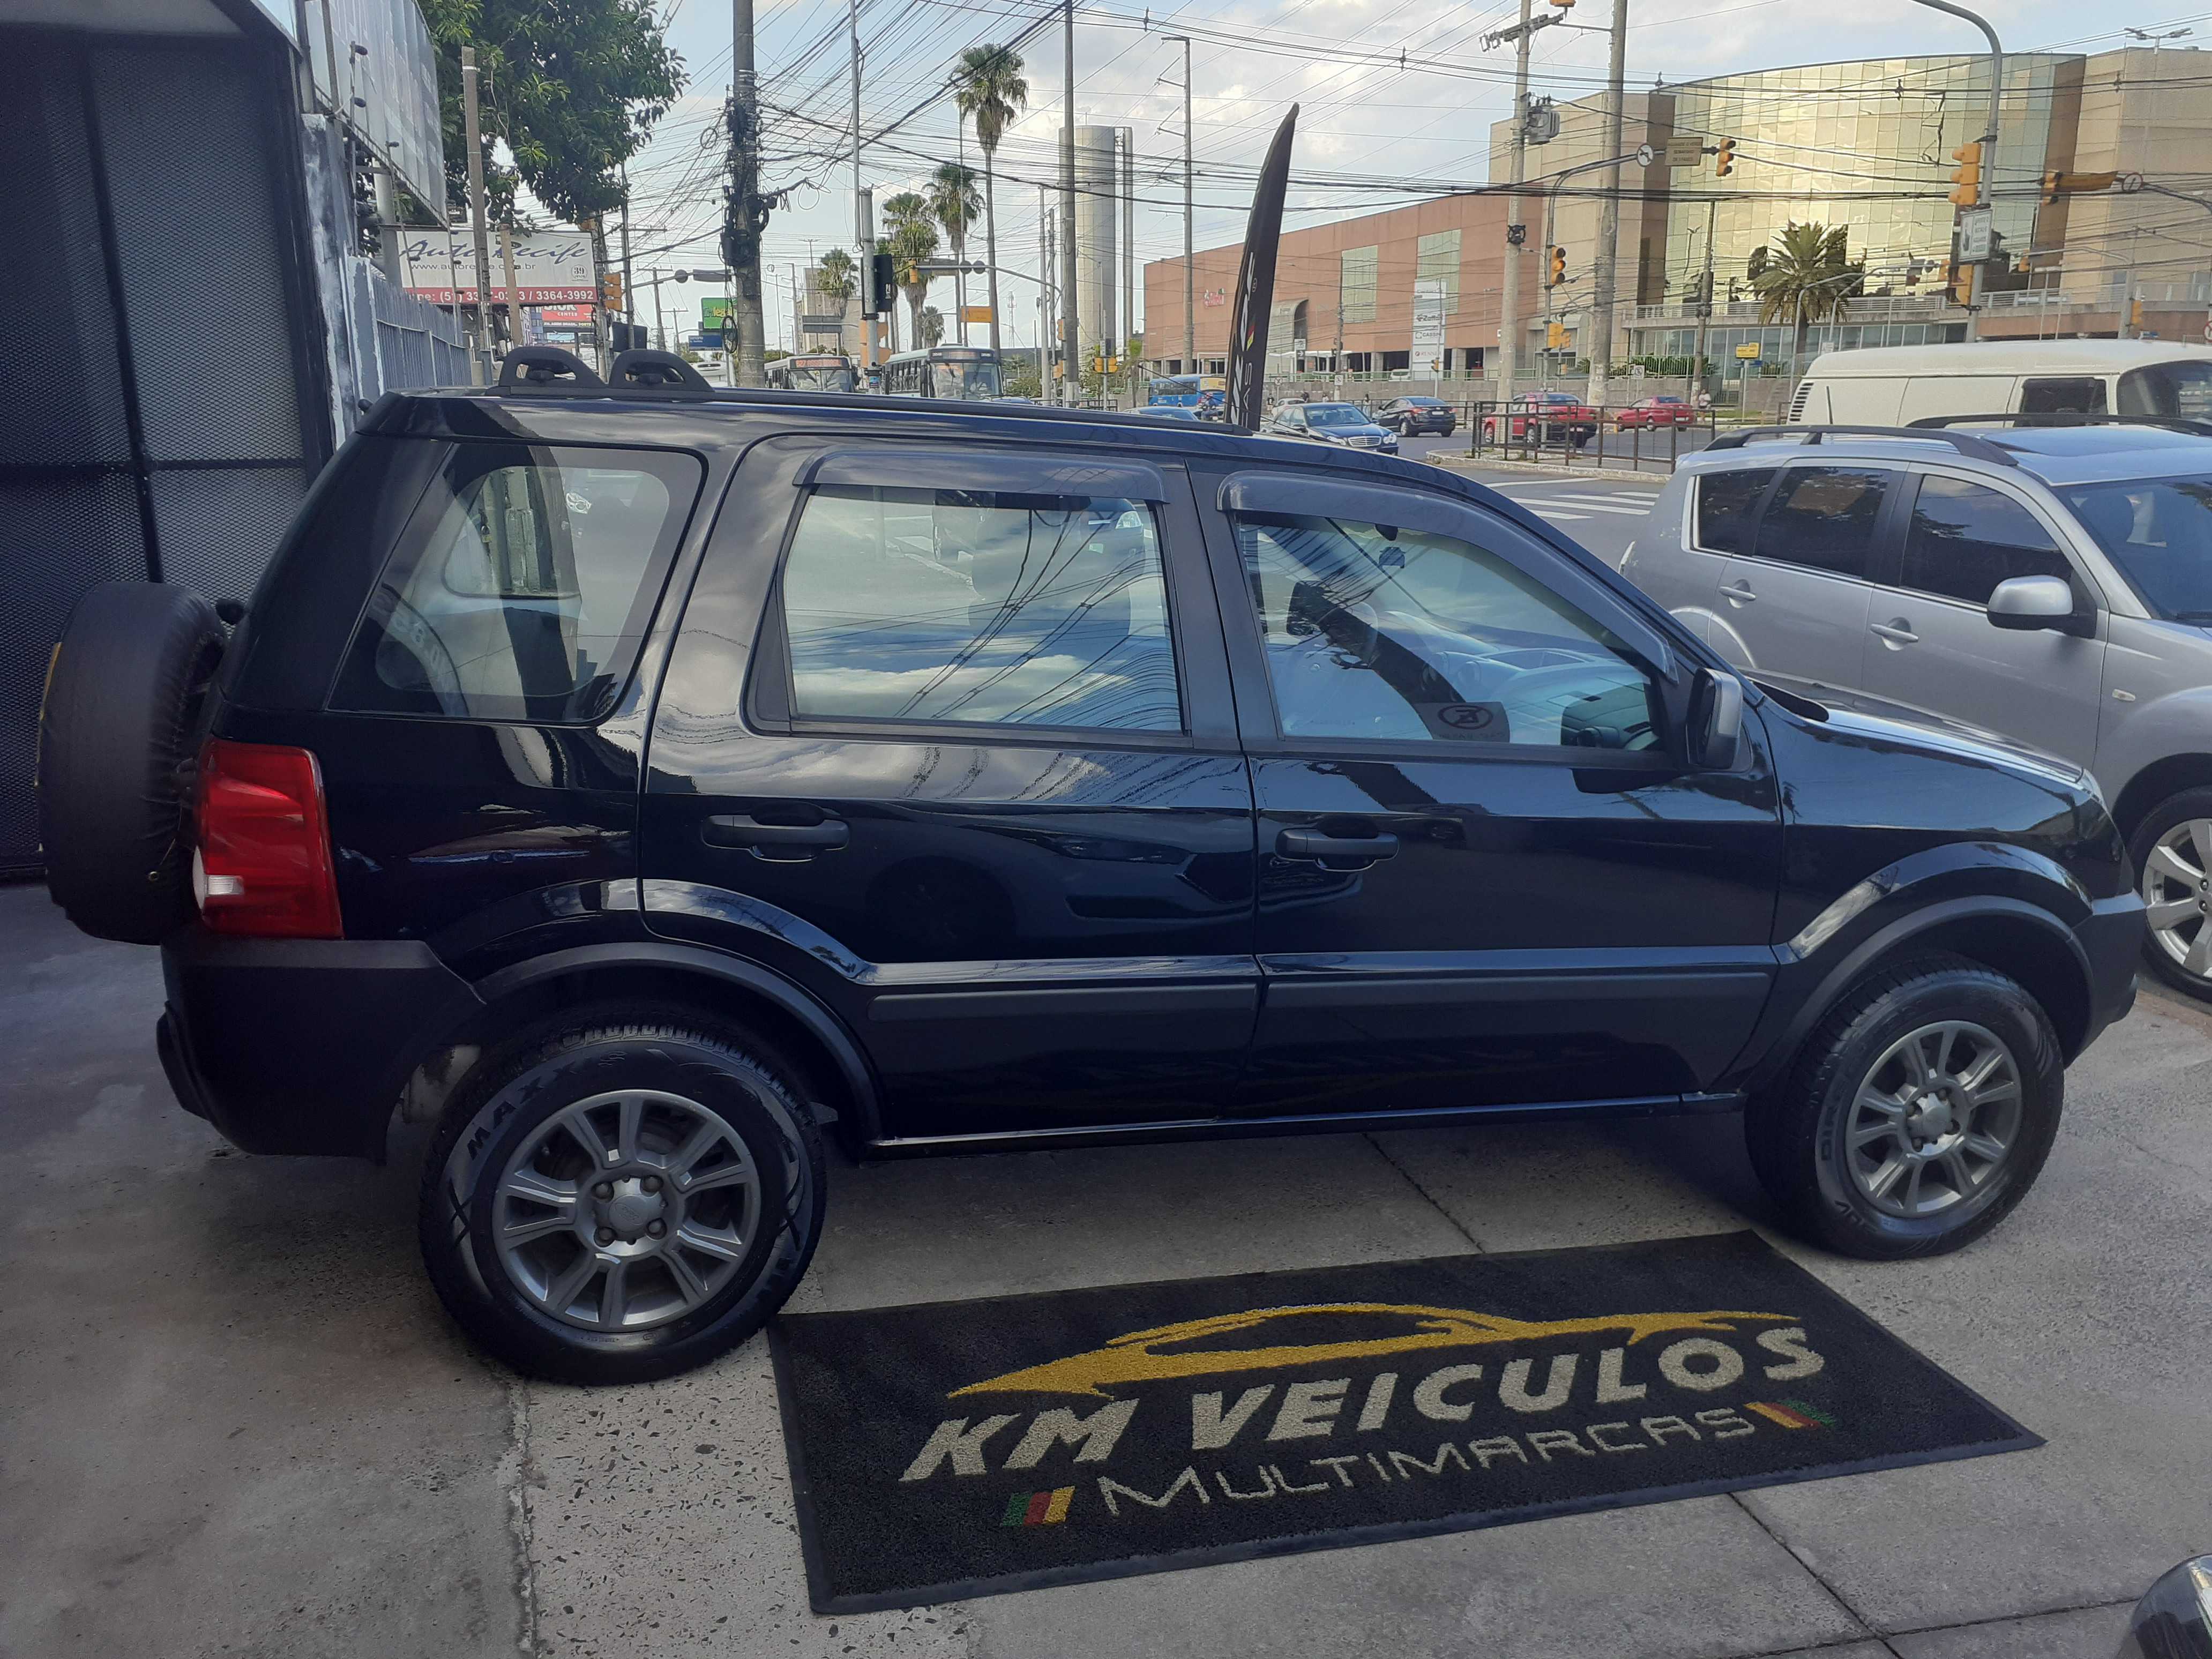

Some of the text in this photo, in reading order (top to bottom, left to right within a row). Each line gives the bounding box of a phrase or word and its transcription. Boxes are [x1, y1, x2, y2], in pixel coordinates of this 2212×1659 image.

[536, 290, 594, 300] 3364-3992
[898, 1327, 1824, 1482] KM VEICULOS
[1096, 1407, 1755, 1516] MULTIMARCAS
